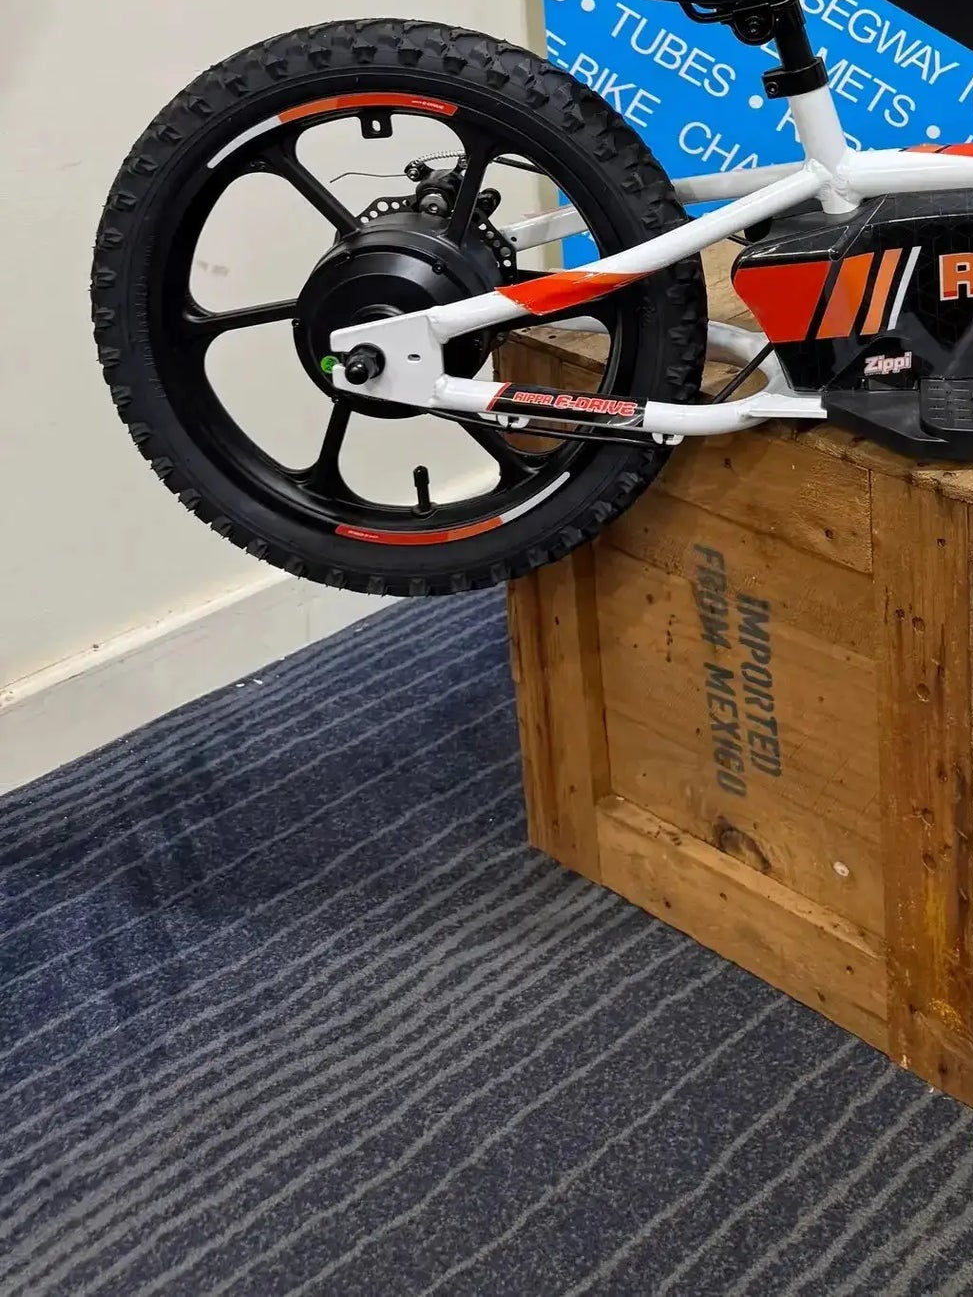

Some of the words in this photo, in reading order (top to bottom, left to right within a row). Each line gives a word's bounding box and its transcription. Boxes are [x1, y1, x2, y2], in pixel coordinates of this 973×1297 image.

[611, 2, 736, 98] TUBES
[513, 391, 553, 406] RIPPA
[553, 394, 637, 418] E-DRIVE
[864, 351, 912, 376] Zippi
[703, 662, 748, 798] MEXICO
[736, 591, 782, 778] IMPORTED
